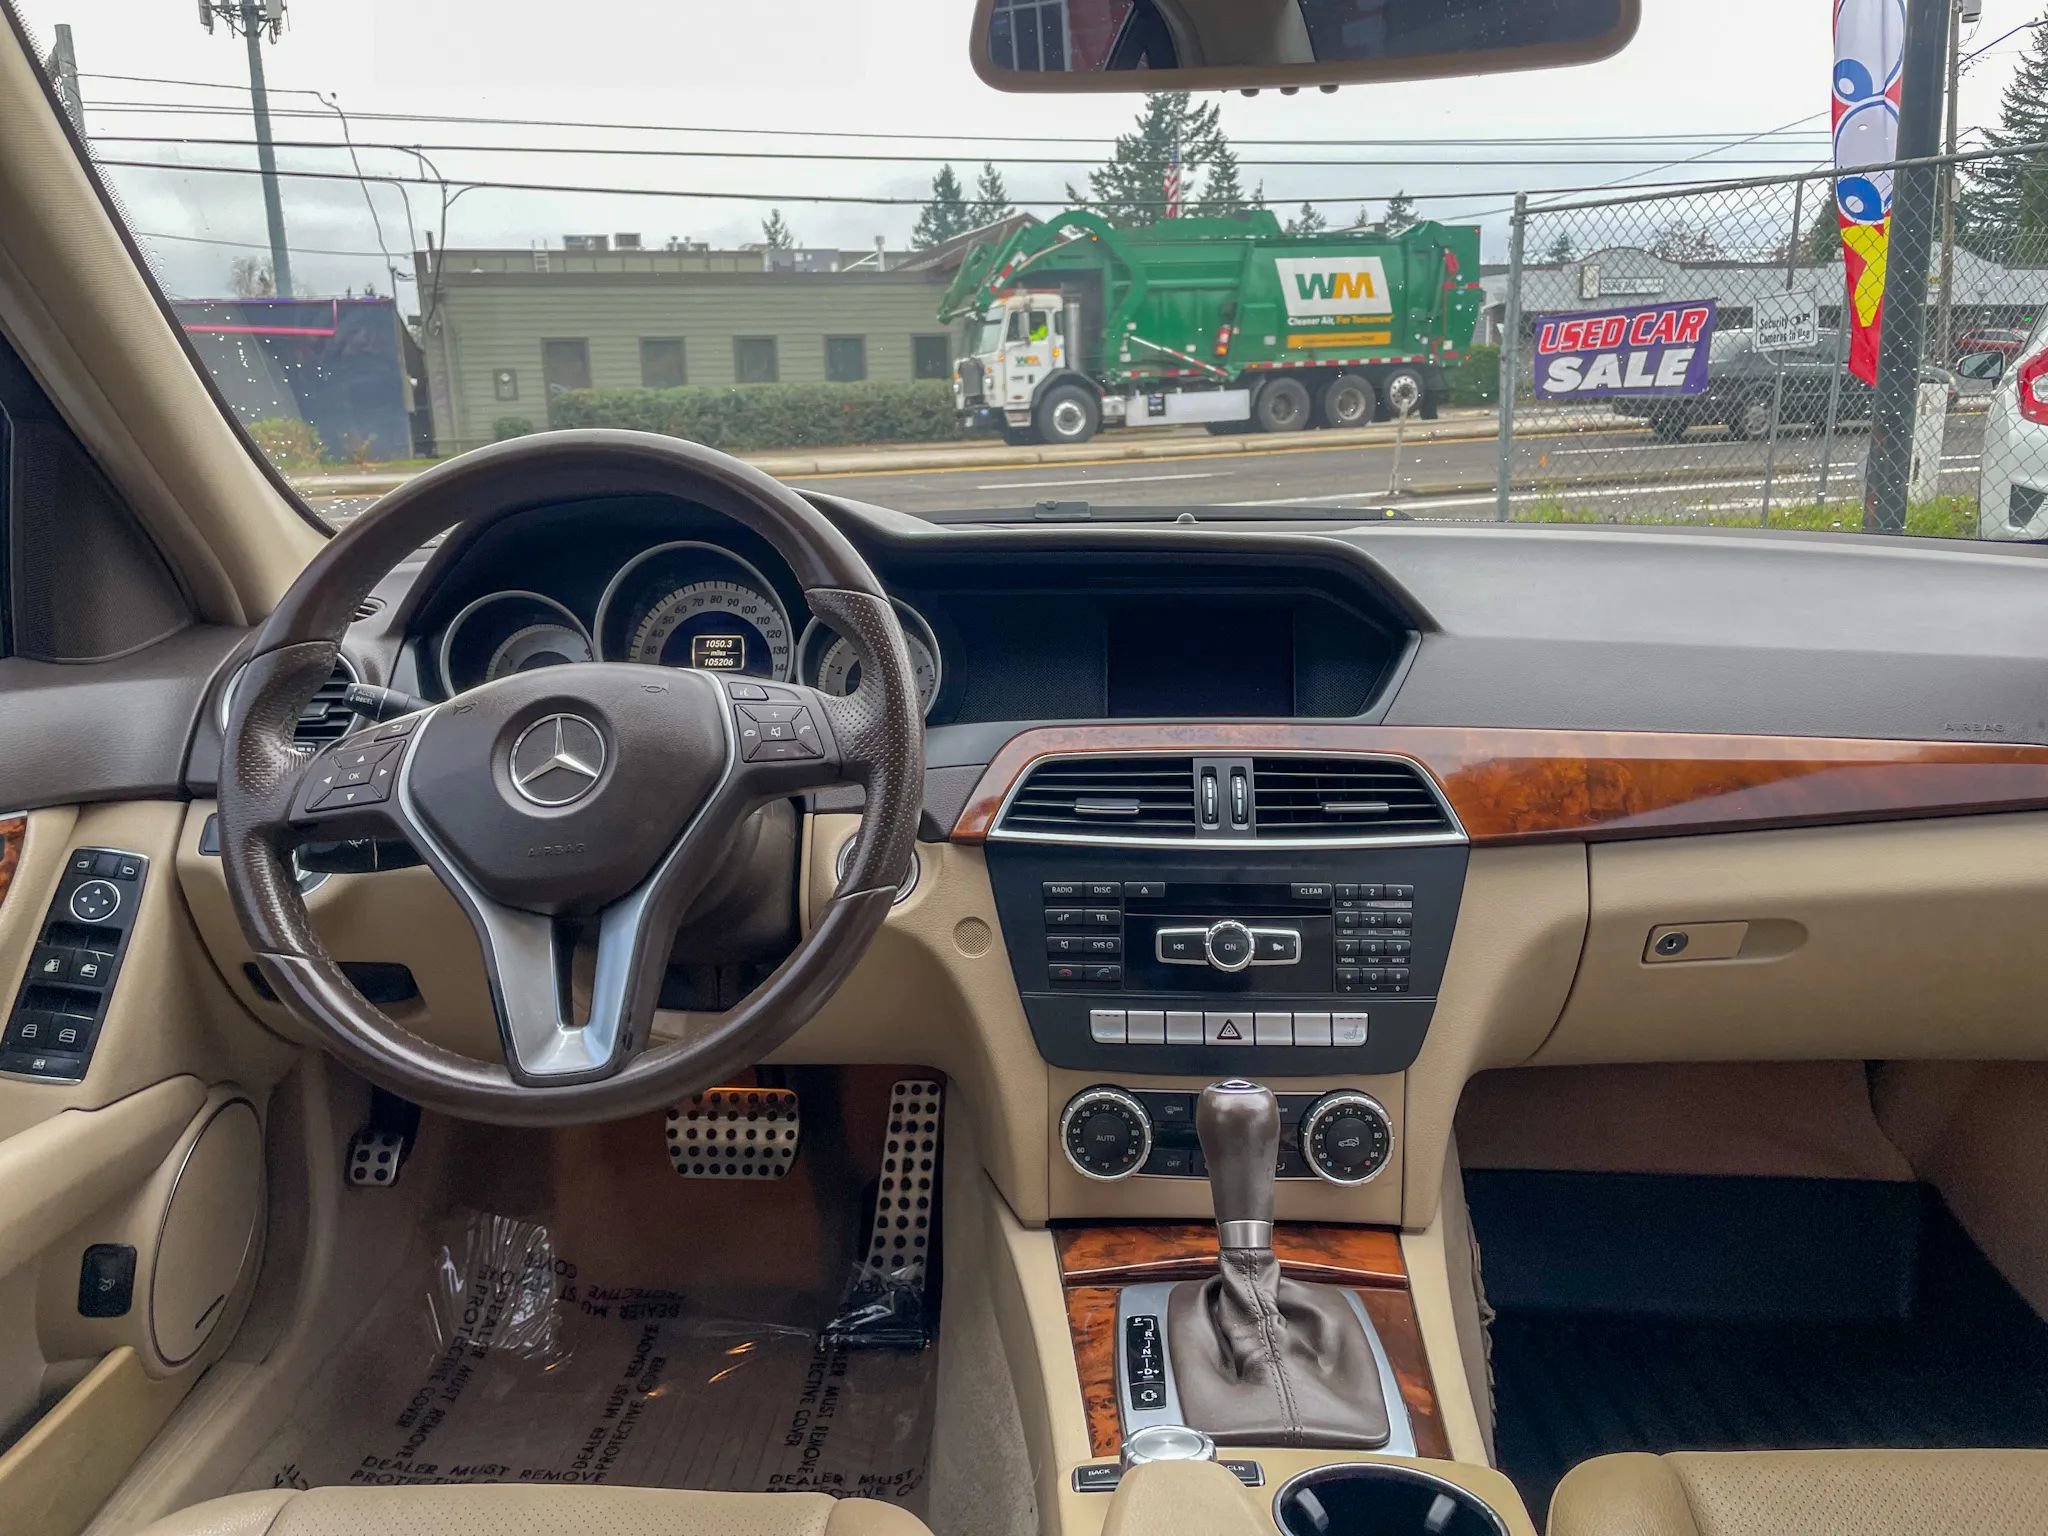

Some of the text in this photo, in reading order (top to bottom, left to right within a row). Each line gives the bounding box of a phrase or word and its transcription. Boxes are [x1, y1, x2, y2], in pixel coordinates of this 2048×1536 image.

[1295, 272, 1376, 300] WM
[1538, 308, 1709, 355] USED CAR
[1543, 348, 1695, 393] SALE
[692, 598, 704, 607] 70
[709, 595, 723, 604] 80
[727, 598, 739, 607] 90
[675, 605, 687, 614] 60
[741, 606, 757, 614] 100
[662, 616, 675, 625] 50
[756, 616, 770, 625] 110
[766, 630, 782, 638] 120
[705, 640, 733, 648] 1050.3
[704, 658, 734, 666] 105206
[836, 666, 843, 675] 2
[1300, 887, 1323, 895] CLEAR
[1369, 888, 1375, 896] 2
[1224, 943, 1237, 951] ON
[1371, 972, 1377, 980] 0
[441, 1365, 474, 1403] MUST
[570, 1426, 609, 1469] DEALER
[624, 1323, 660, 1378] REMOVE
[784, 1342, 828, 1447] OTECTIVE COVER
[816, 1385, 840, 1418] MUST
[396, 1386, 436, 1428] COVER
[396, 1407, 446, 1458] REMOVE
[594, 1399, 646, 1470] PROTECTIVE
[797, 1425, 829, 1474] REMOVE
[361, 1455, 608, 1483] DEALER MUST REMOVE
[1088, 1468, 1111, 1476] BACK
[1226, 1464, 1245, 1472] CLR
[769, 1472, 844, 1487] DEALER
[858, 1467, 916, 1486] MUST
